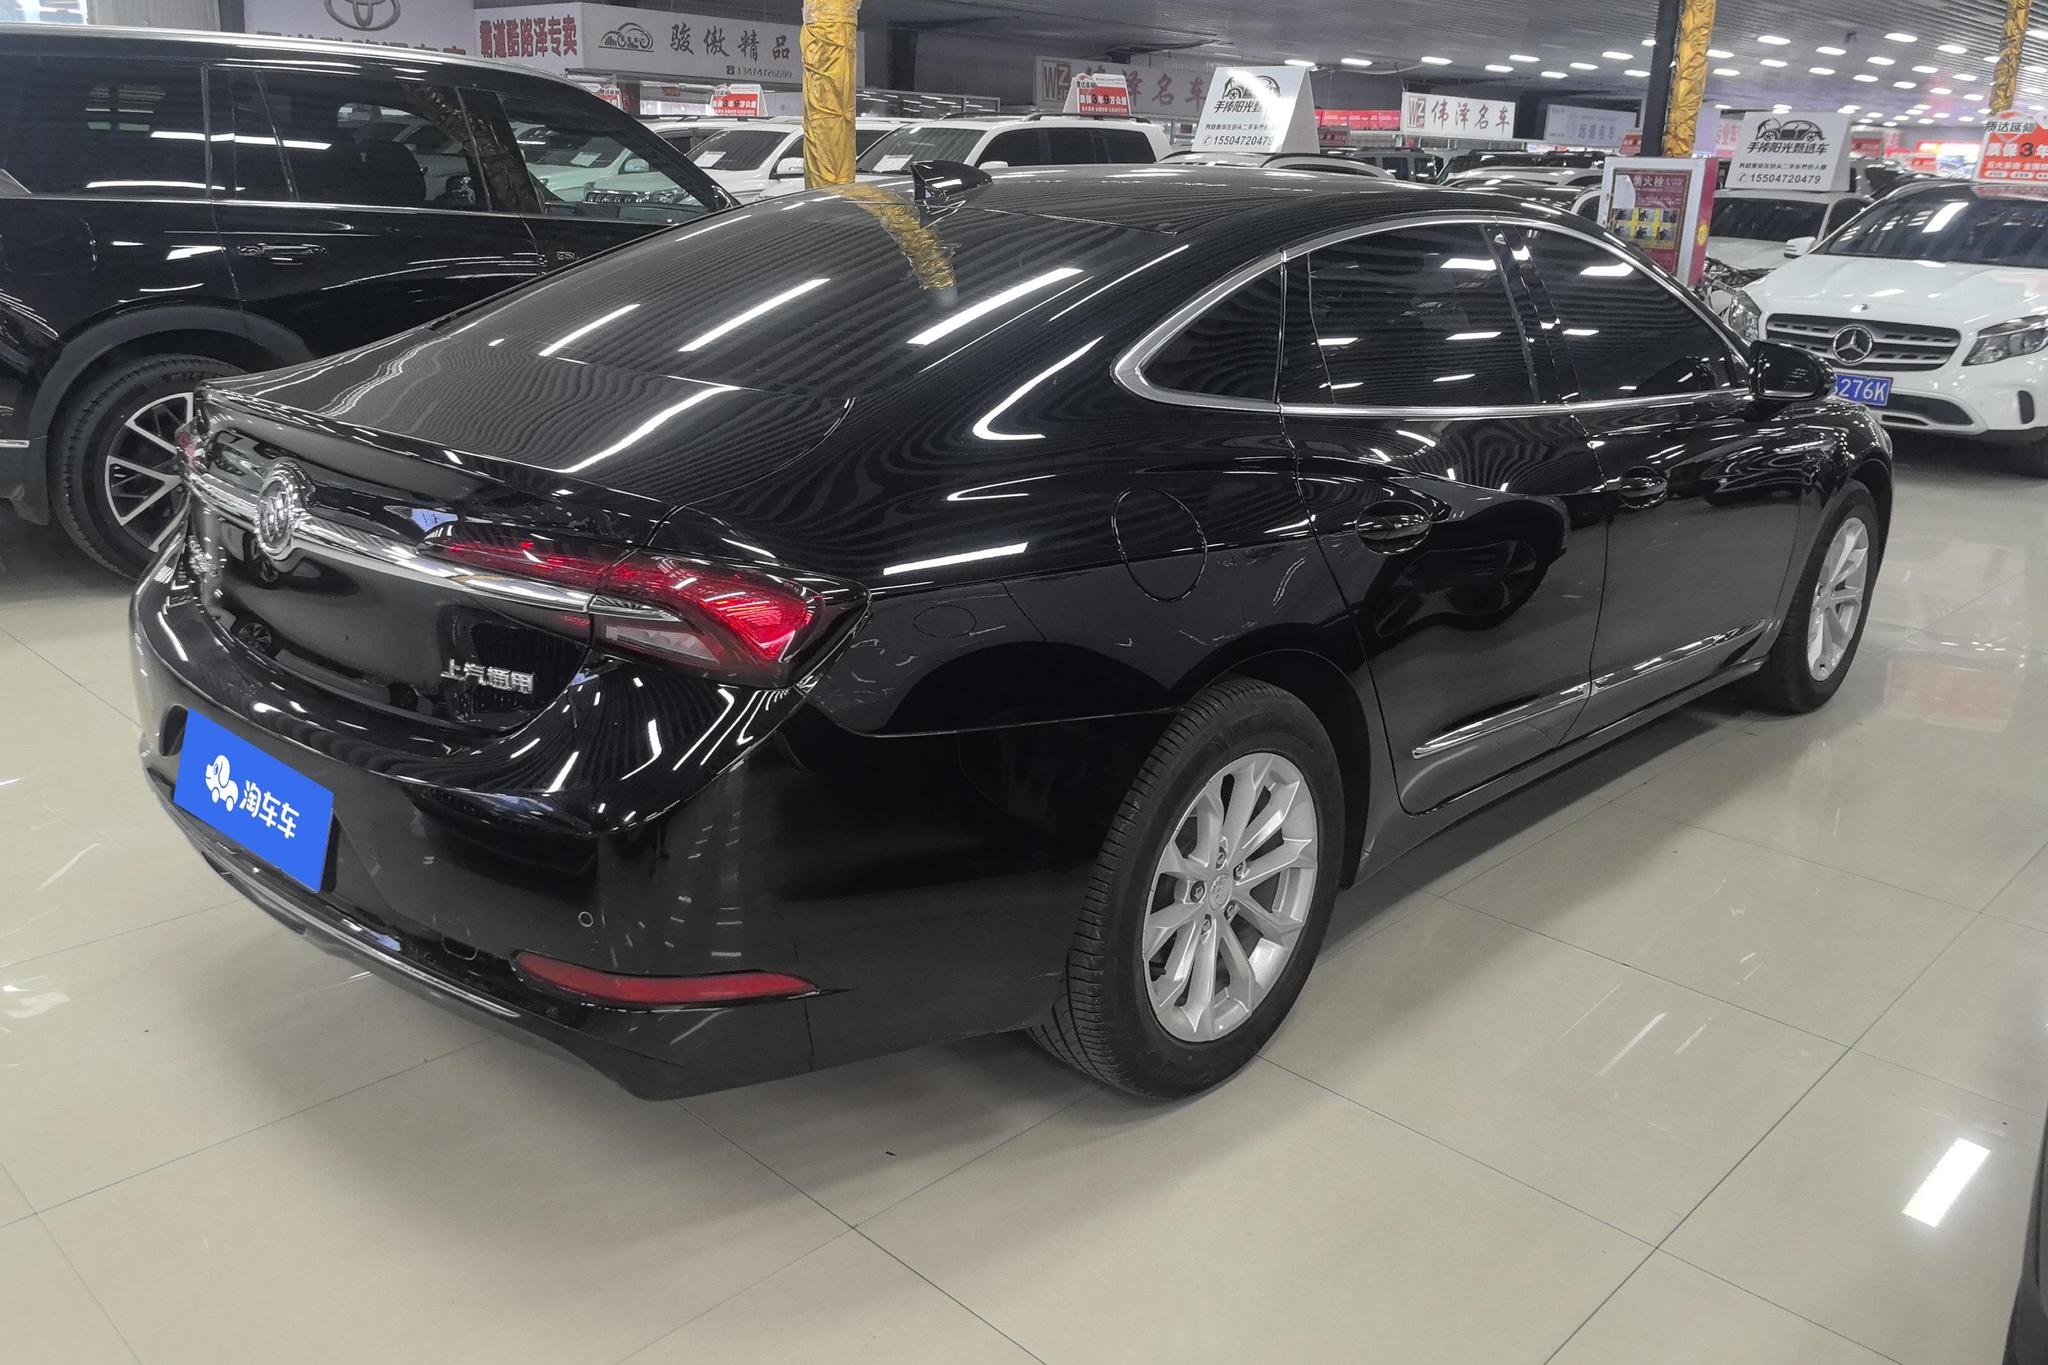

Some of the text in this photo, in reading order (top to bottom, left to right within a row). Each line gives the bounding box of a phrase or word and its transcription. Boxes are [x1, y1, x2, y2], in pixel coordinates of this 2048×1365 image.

[670, 22, 791, 62] 骏傲精品
[1431, 98, 1510, 136] 伟泽名车
[1750, 173, 1822, 184] 15504720479
[1834, 378, 1887, 402] 276K
[441, 659, 533, 694] 上汽通用
